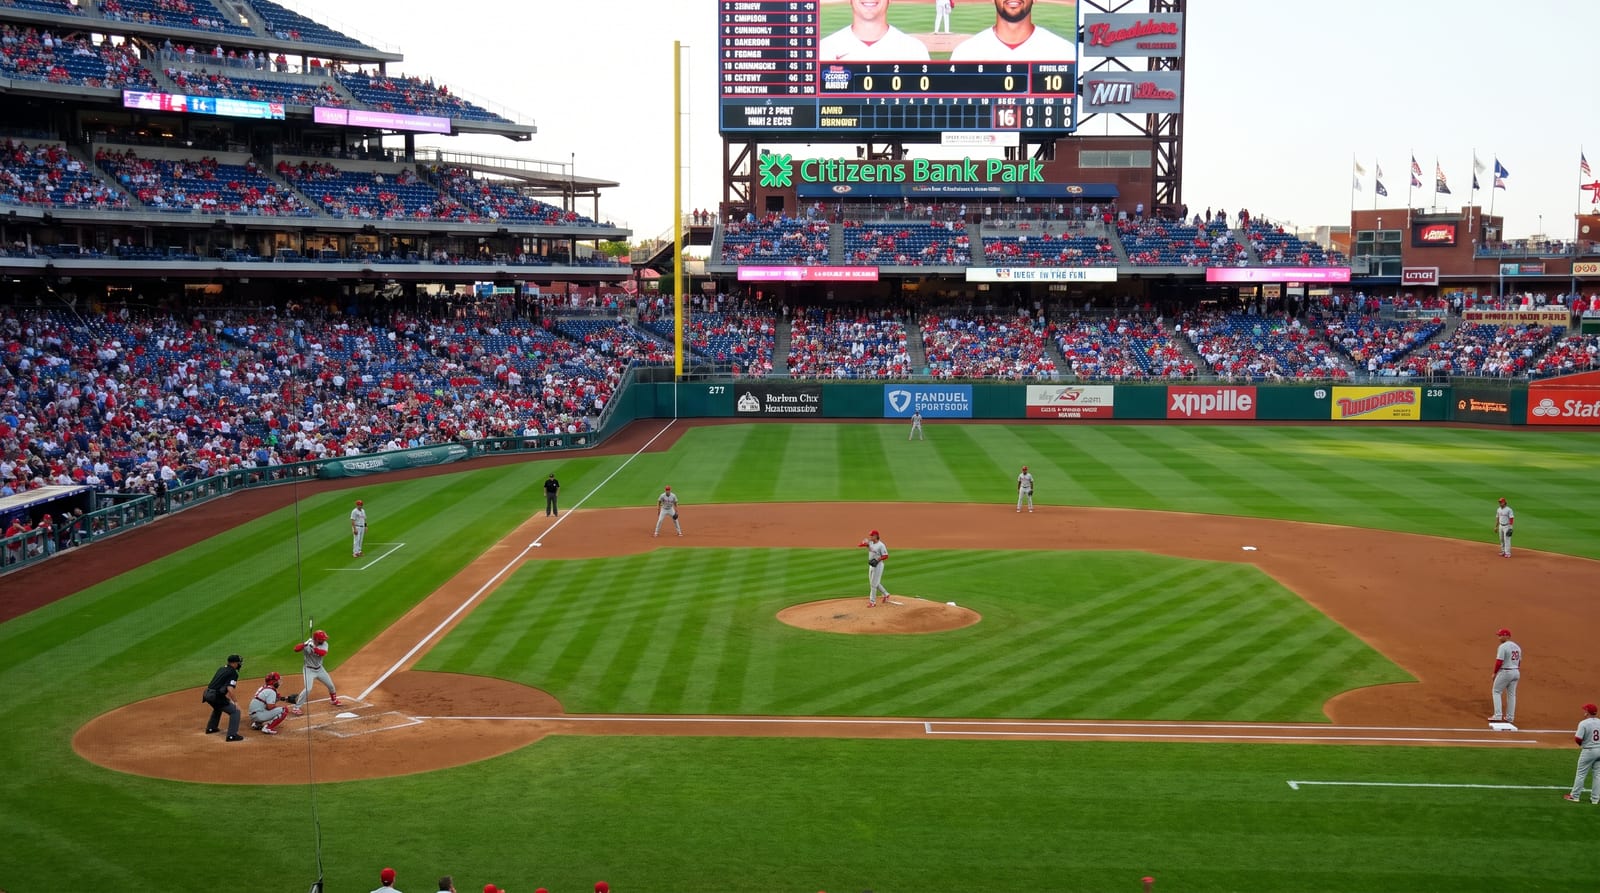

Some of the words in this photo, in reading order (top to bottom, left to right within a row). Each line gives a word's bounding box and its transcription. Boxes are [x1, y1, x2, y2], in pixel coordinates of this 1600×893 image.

[866, 65, 870, 73] 1
[894, 65, 899, 73] 2
[922, 65, 928, 73] 3
[950, 65, 955, 73] 4
[864, 76, 873, 91] 0
[892, 76, 901, 91] 0
[920, 76, 929, 91] 0
[1004, 76, 1014, 91] 0
[1044, 76, 1062, 91] 10
[1027, 107, 1033, 116] 0
[1045, 107, 1052, 116] 0
[1064, 107, 1071, 116] 0
[998, 110, 1015, 126] 16
[1027, 118, 1033, 127] 0
[1045, 118, 1052, 127] 0
[1064, 118, 1071, 127] 0
[801, 158, 905, 182] Citizens
[913, 158, 978, 182] Bank
[986, 158, 1044, 182] Park
[709, 386, 725, 394] 277
[915, 392, 968, 402] FANDUEL
